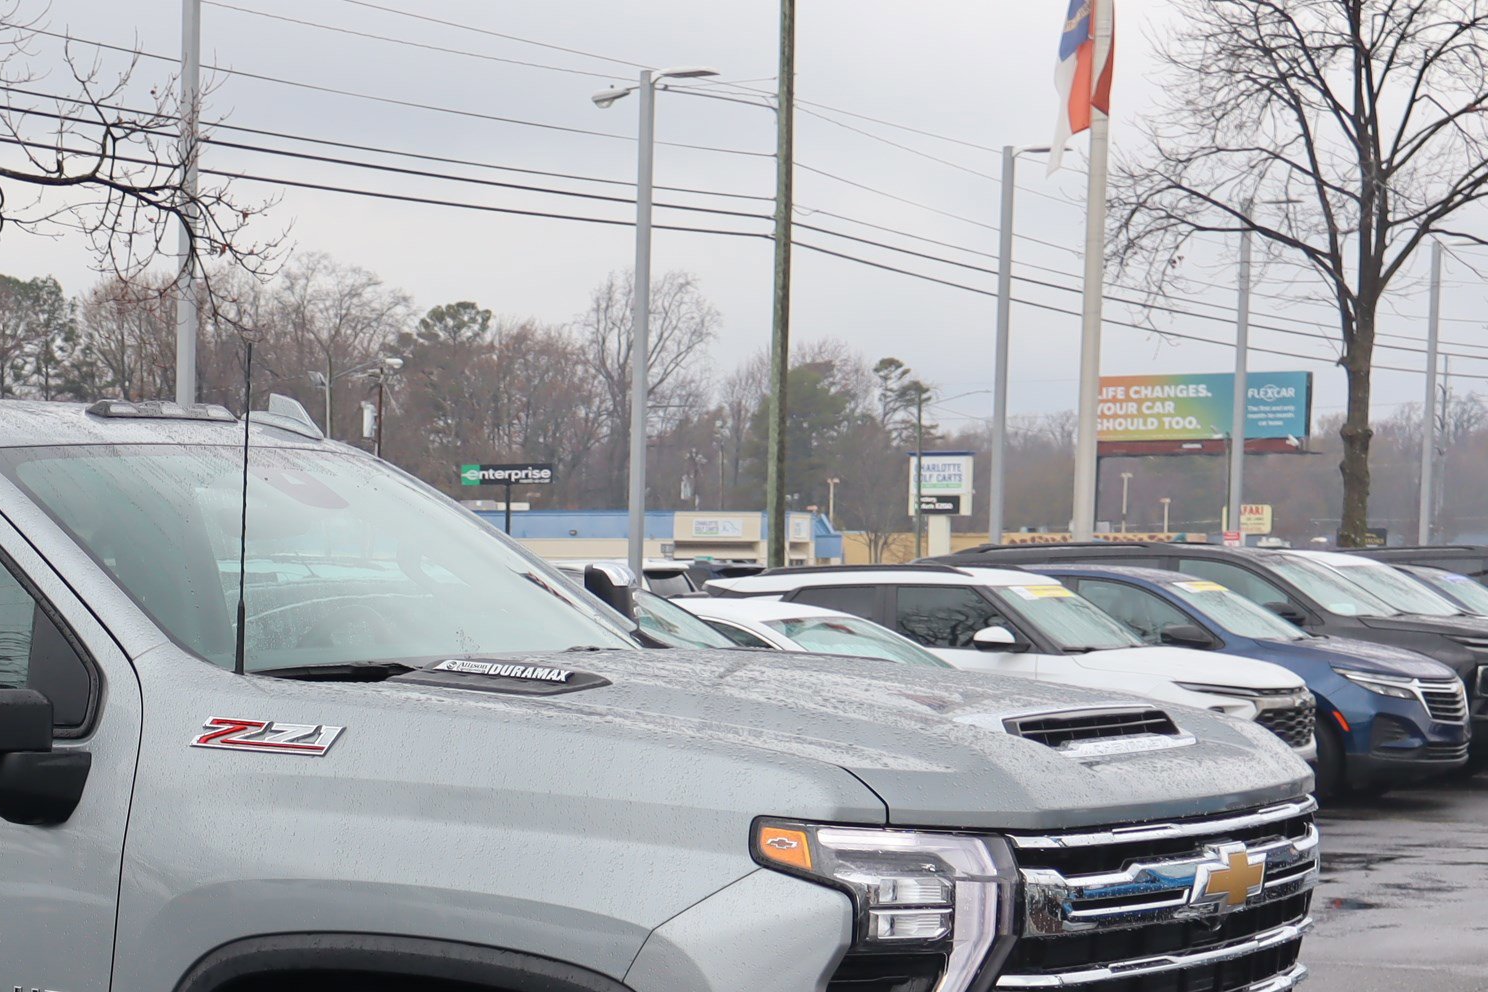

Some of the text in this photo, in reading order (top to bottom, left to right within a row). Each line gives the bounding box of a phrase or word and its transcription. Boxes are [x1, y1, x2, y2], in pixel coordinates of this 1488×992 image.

[1098, 384, 1212, 399] IFE CHANGES.
[1247, 385, 1295, 400] FLEXCAR
[1142, 401, 1175, 414] CAR
[1163, 416, 1202, 430] TOO.
[461, 466, 552, 482] enterprise
[488, 663, 571, 682] DURAMAX
[190, 716, 346, 756] Z71
